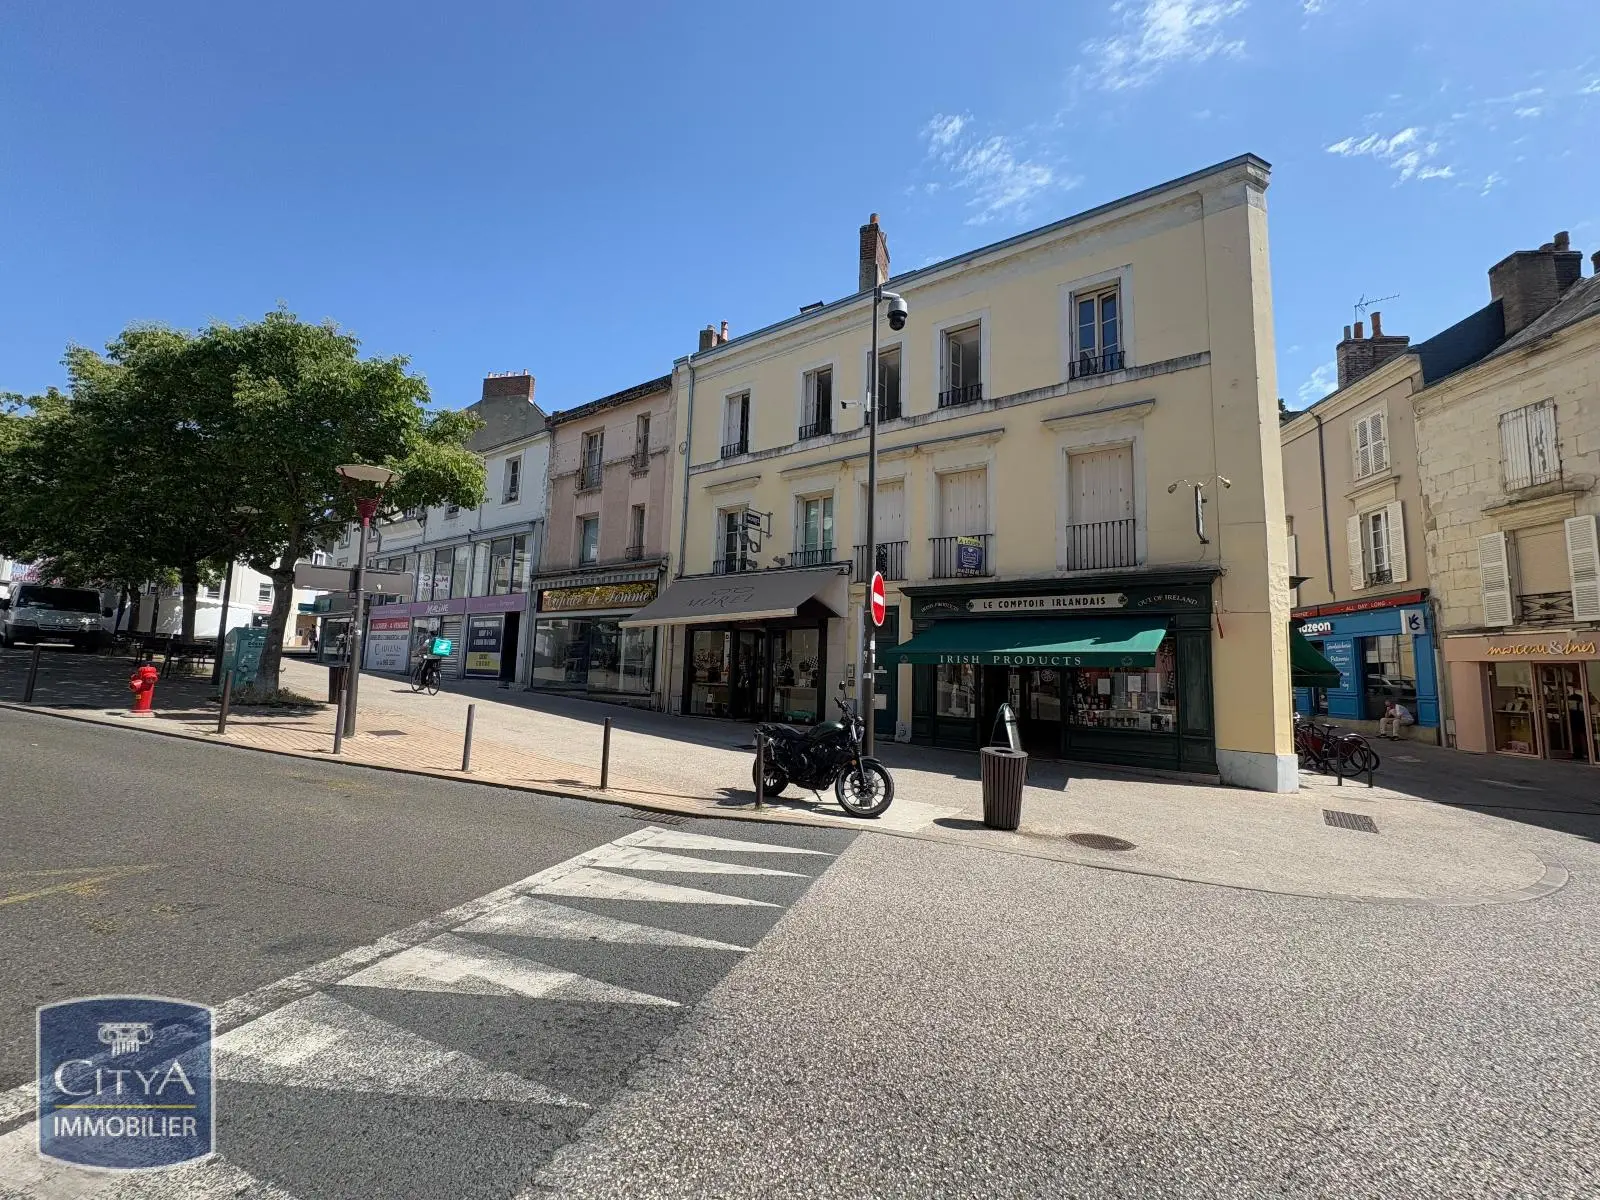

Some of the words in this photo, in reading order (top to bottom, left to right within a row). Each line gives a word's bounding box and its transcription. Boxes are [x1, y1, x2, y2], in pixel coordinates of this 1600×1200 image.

[983, 601, 993, 609] LE
[998, 599, 1045, 609] COMPTOIR
[1051, 596, 1106, 607] IRLANDAIS
[1137, 597, 1152, 607] OUT
[1164, 594, 1198, 606] IRELAND
[940, 655, 980, 664] IRISH
[993, 655, 1081, 666] PRODUCTS
